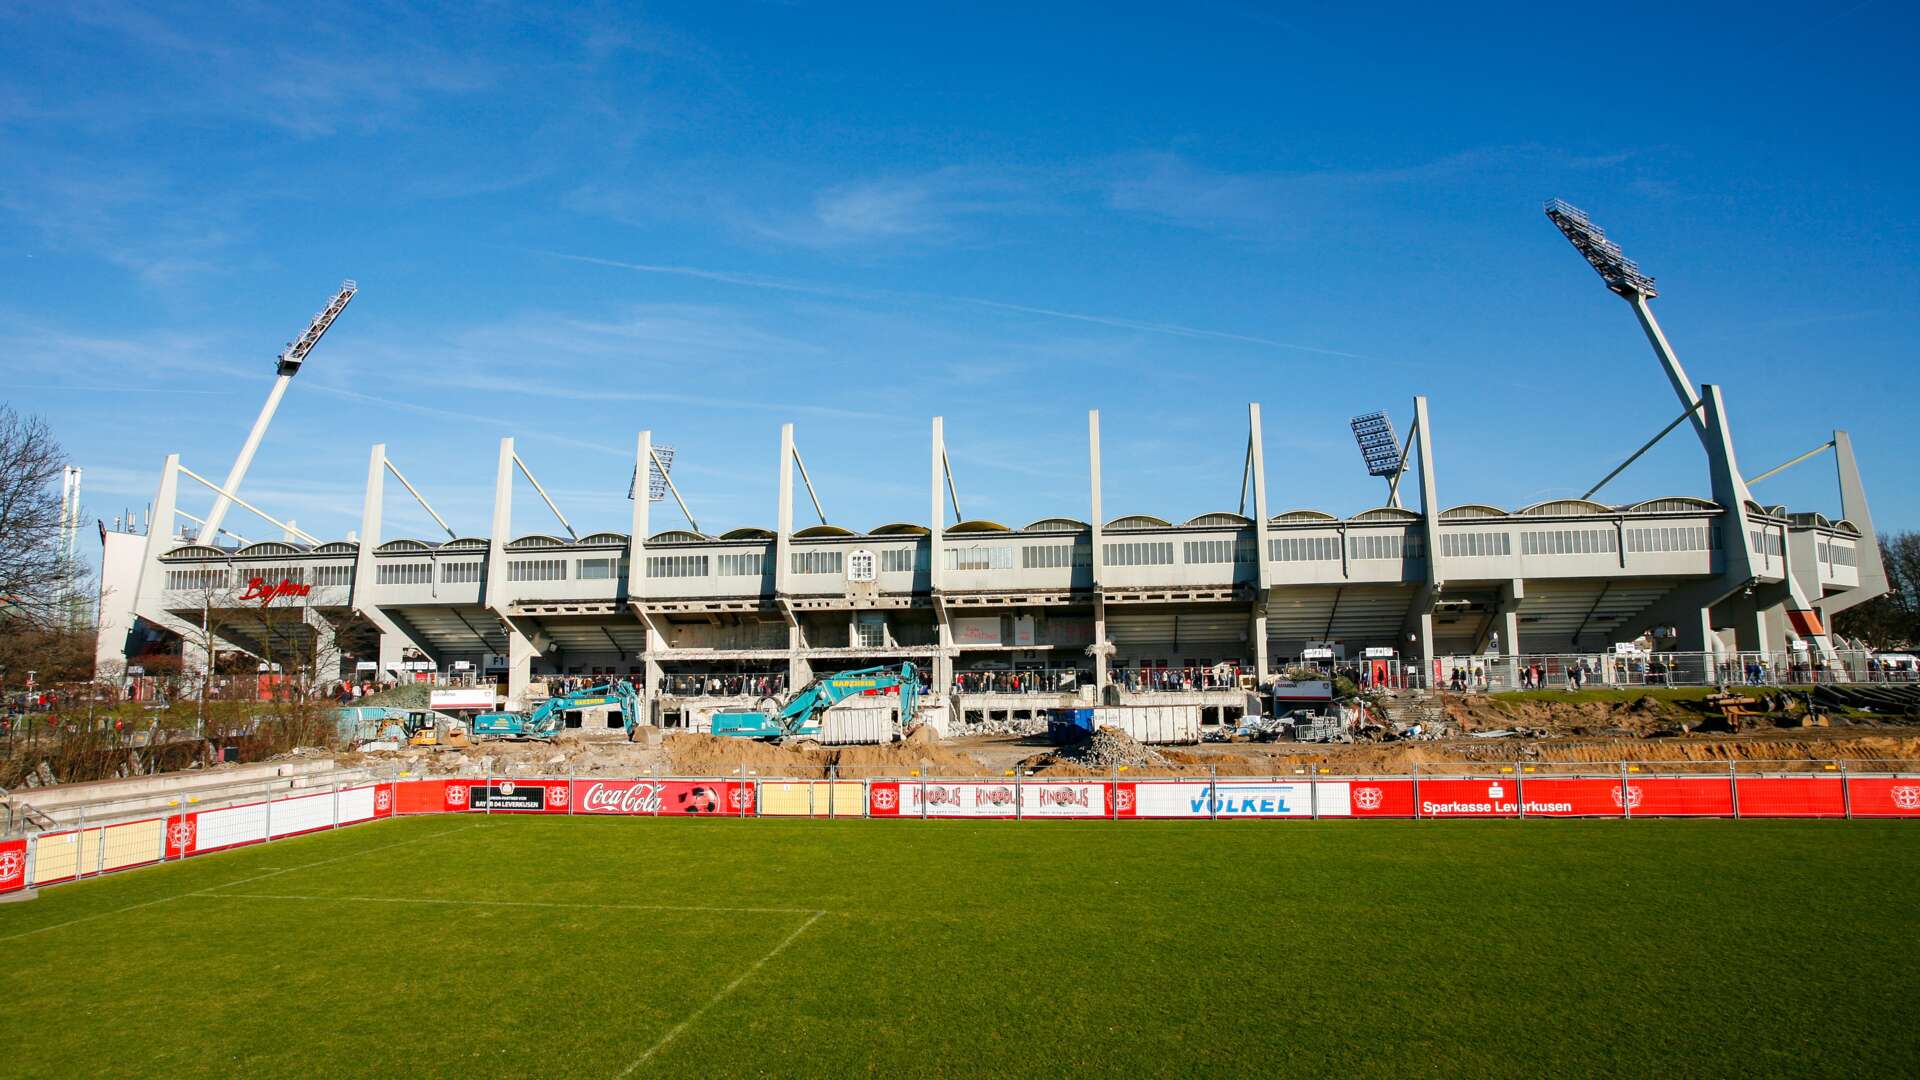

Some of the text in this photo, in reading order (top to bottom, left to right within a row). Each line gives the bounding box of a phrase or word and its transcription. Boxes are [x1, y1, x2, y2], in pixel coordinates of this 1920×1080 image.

[493, 656, 504, 665] F1
[584, 782, 667, 812] Coca-Cola
[976, 786, 1024, 807] KINOPOLS
[1039, 786, 1089, 808] KINOPOLIS
[1423, 801, 1572, 815] Sparkasse Leverkusen
